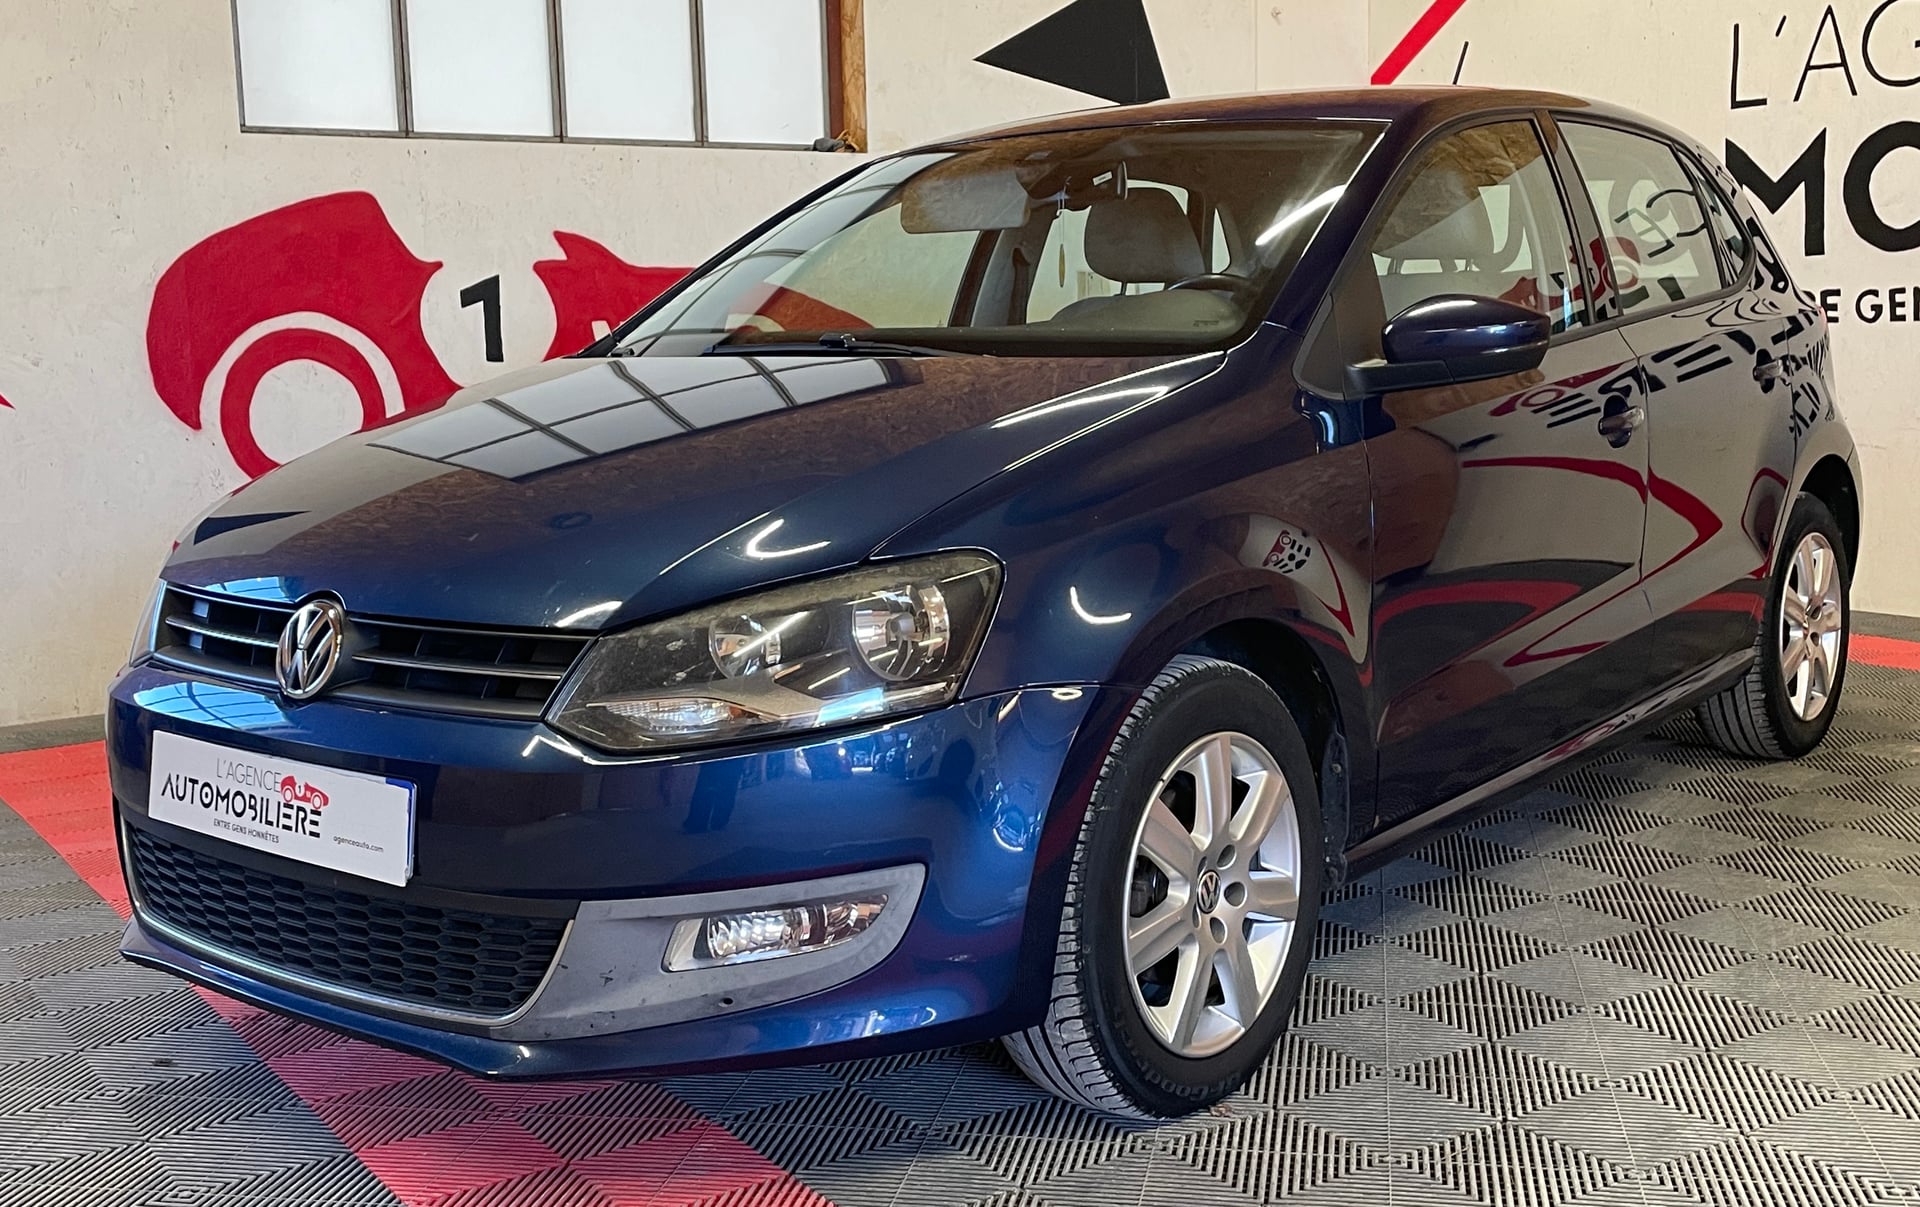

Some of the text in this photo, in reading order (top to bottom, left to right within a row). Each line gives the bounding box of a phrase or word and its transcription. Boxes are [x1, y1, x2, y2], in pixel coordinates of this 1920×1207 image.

[460, 275, 504, 362] 1
[1855, 286, 1920, 323] GE
[216, 758, 282, 793] L'AGENCE
[213, 818, 231, 830] ENTRE
[231, 823, 247, 834] GENS
[333, 836, 384, 852] agenceauto.com
